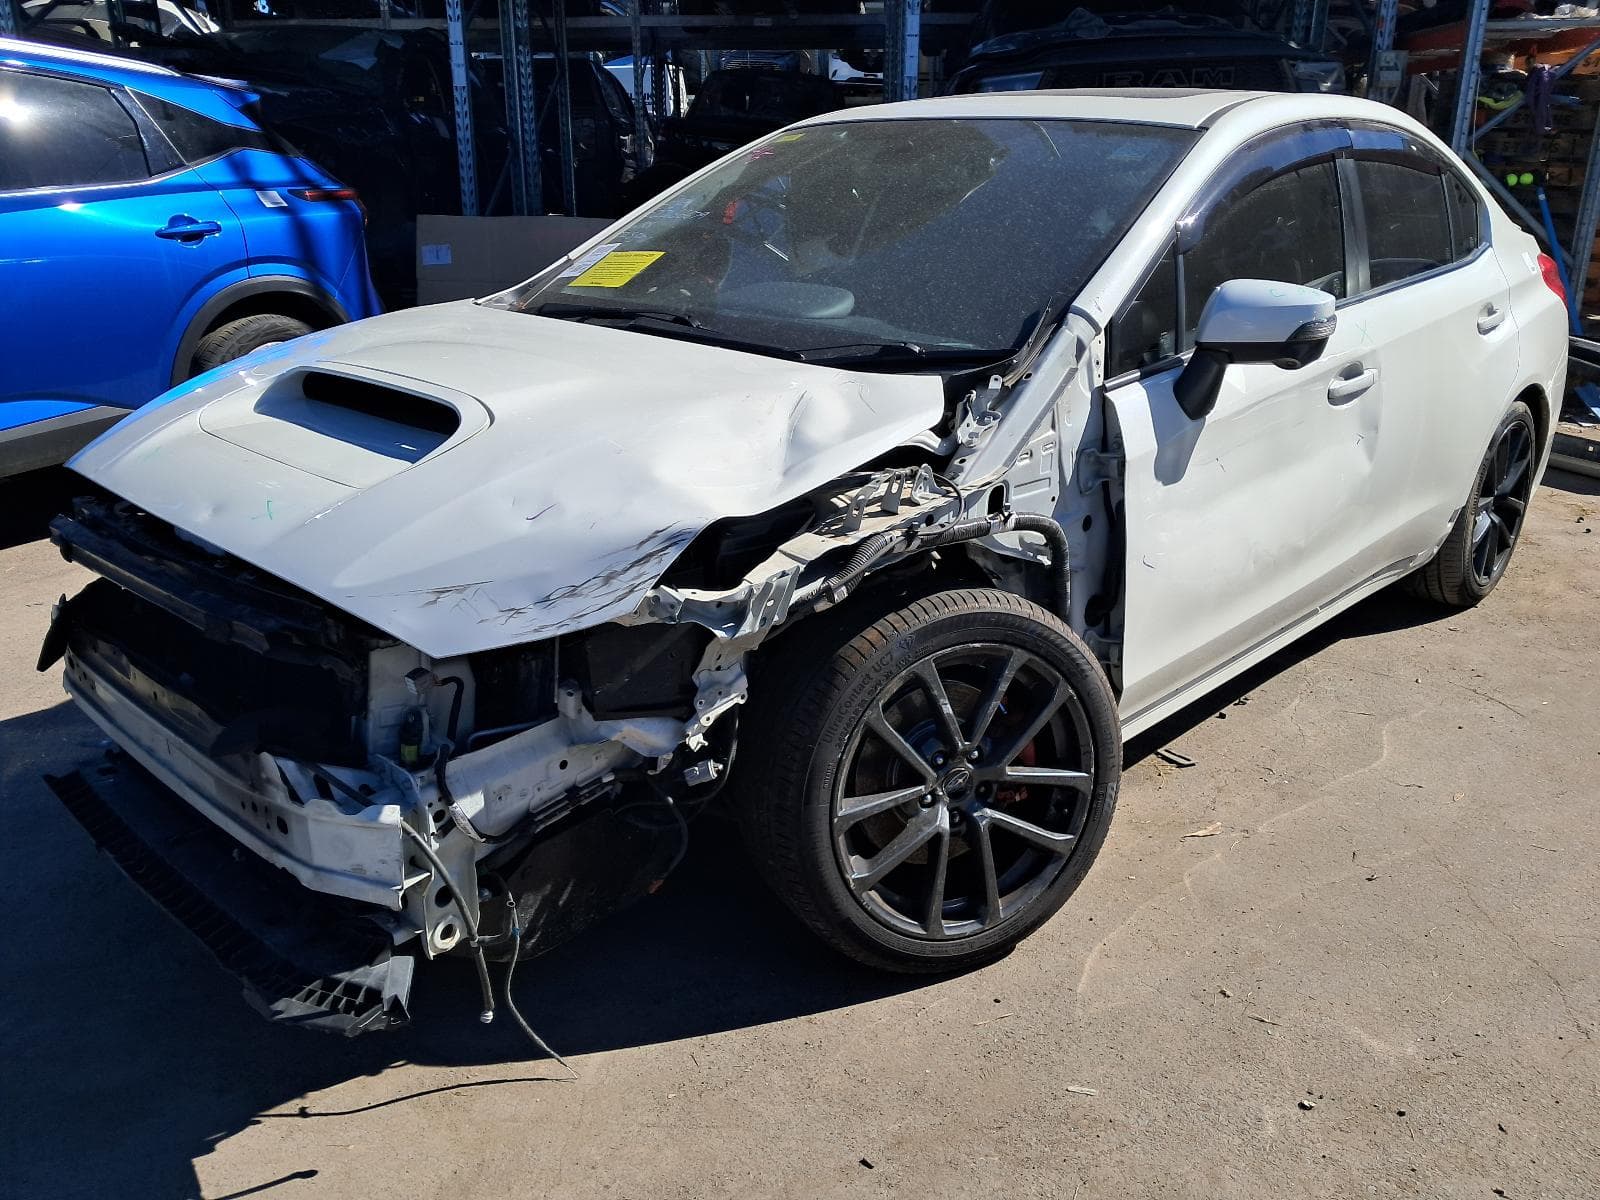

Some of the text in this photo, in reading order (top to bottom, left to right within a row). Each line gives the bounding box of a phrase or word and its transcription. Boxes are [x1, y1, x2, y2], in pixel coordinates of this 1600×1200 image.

[1103, 67, 1236, 87] RAM
[822, 672, 873, 744] UltraContact
[872, 651, 894, 673] UC7
